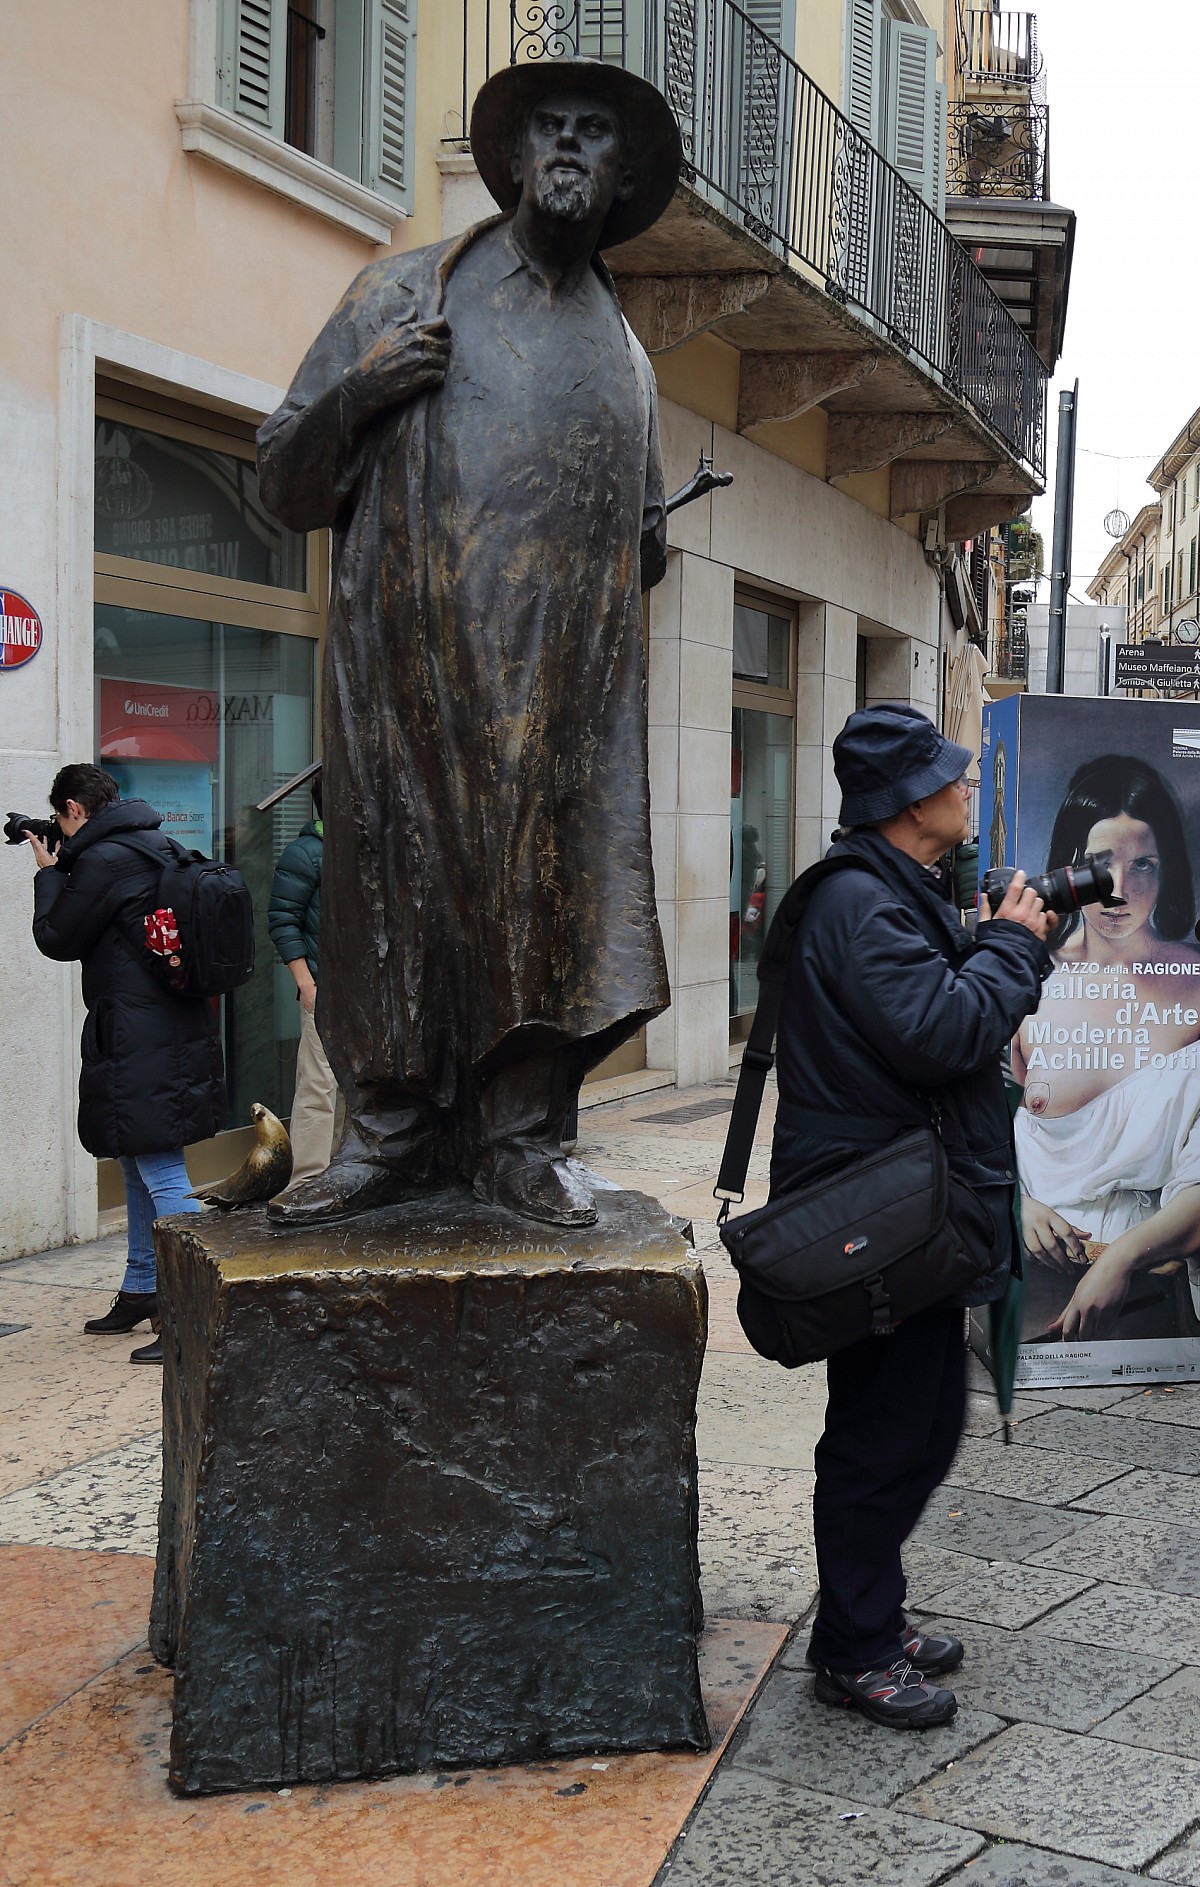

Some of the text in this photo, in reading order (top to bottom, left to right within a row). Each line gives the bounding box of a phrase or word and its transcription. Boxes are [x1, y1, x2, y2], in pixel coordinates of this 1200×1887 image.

[1118, 647, 1145, 657] Arena
[1118, 662, 1192, 673] Museo Maffeiano
[134, 702, 169, 718] UniCredit
[167, 811, 188, 822] Banca
[1053, 962, 1200, 976] LAZZO della RAGIONE
[1115, 1002, 1199, 1025] d'Arte
[1027, 1021, 1150, 1045] Moderna
[1026, 1046, 1198, 1071] Achille Forti
